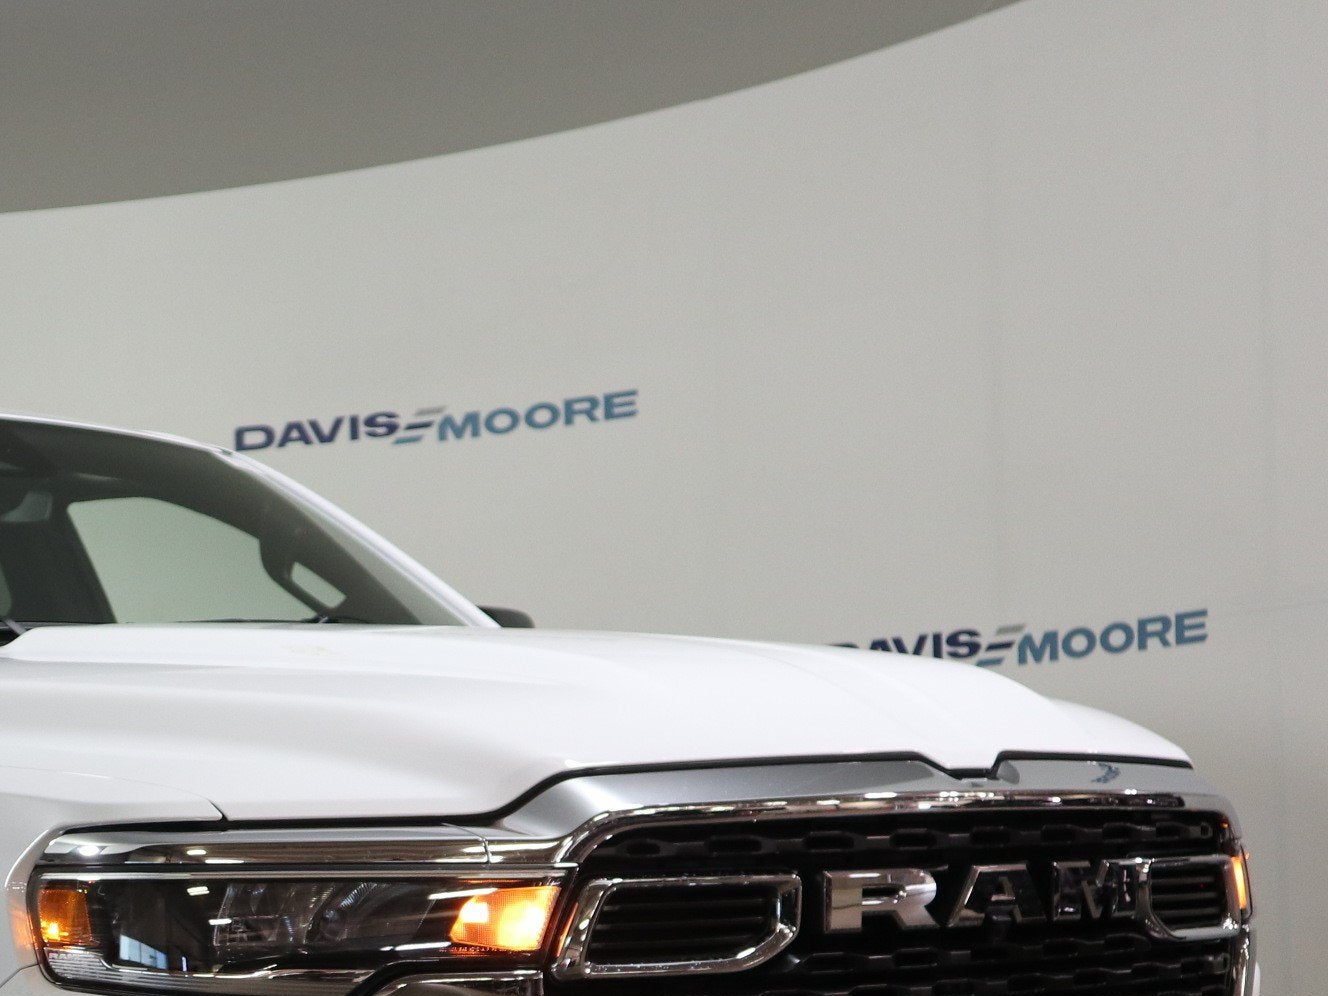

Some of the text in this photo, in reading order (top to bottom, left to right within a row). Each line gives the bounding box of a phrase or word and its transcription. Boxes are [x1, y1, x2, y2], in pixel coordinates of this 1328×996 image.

[234, 389, 639, 451] DAVIS MOORE
[829, 608, 1209, 665] VIS MOORE
[823, 859, 1138, 933] RAM
